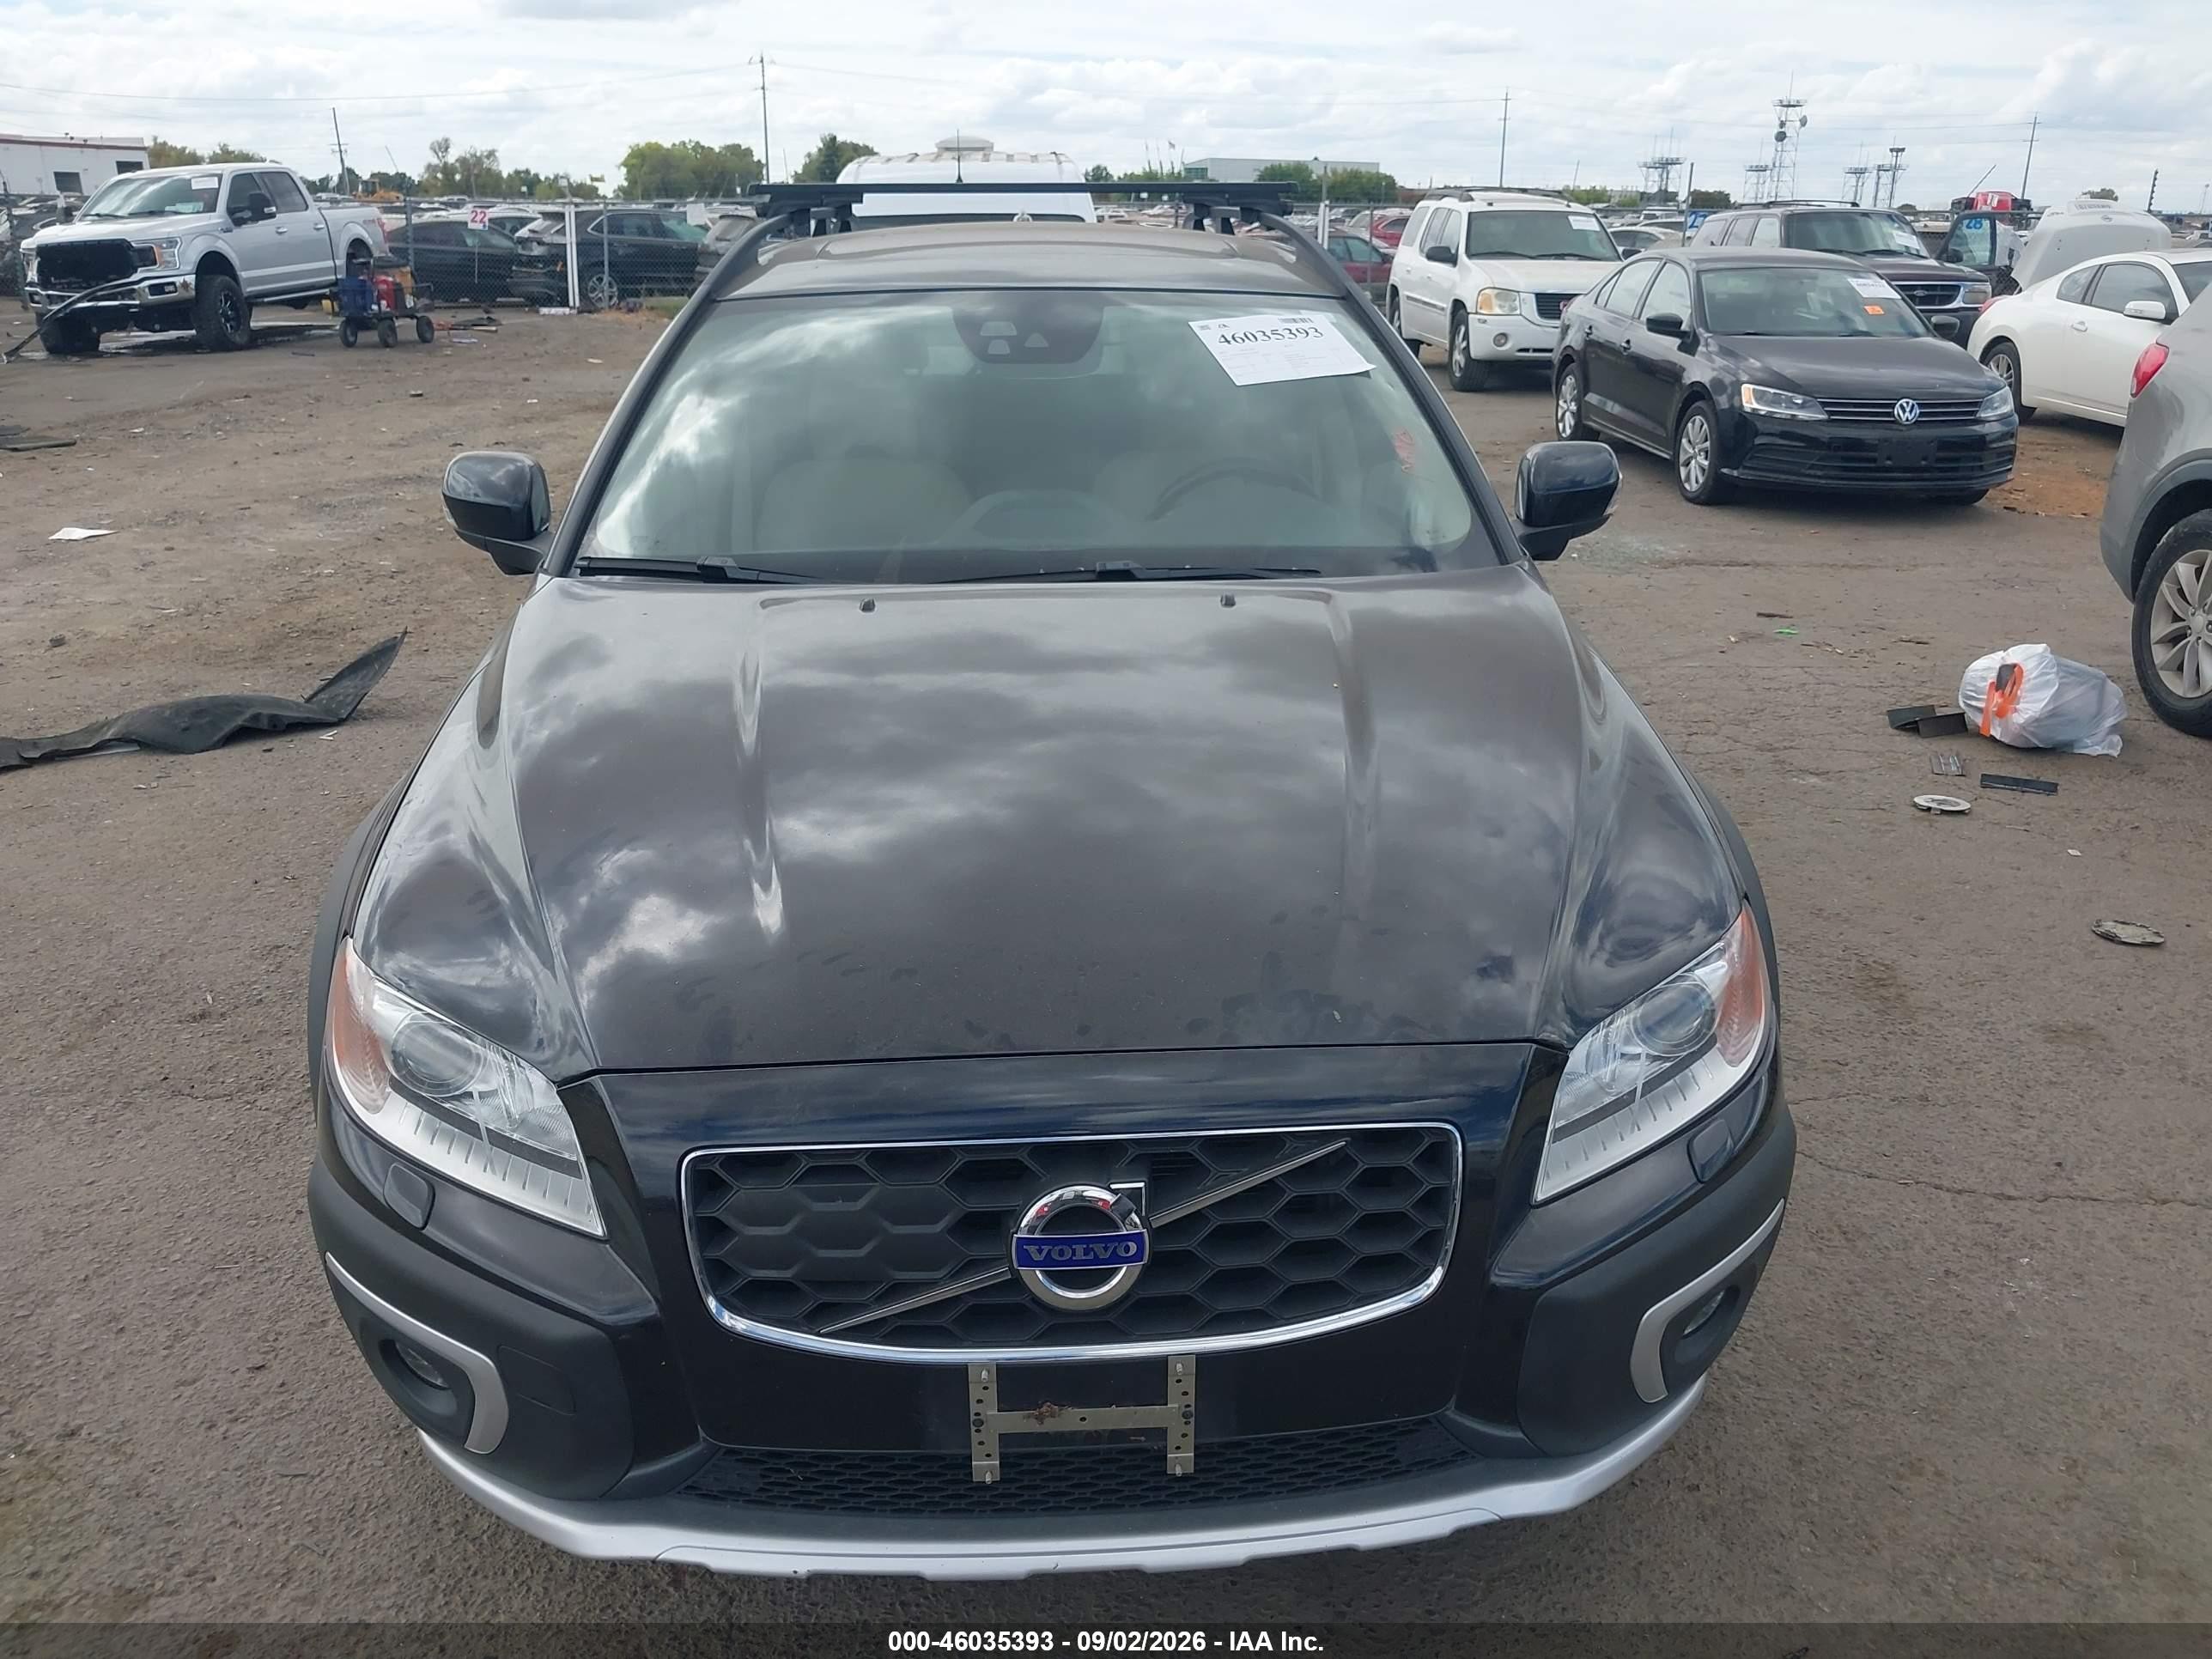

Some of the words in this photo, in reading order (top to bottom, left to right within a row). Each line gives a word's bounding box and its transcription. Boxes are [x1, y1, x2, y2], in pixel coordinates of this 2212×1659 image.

[471, 210, 487, 224] 22
[1218, 326, 1323, 344] 46035393
[1023, 1241, 1137, 1261] VOLVO
